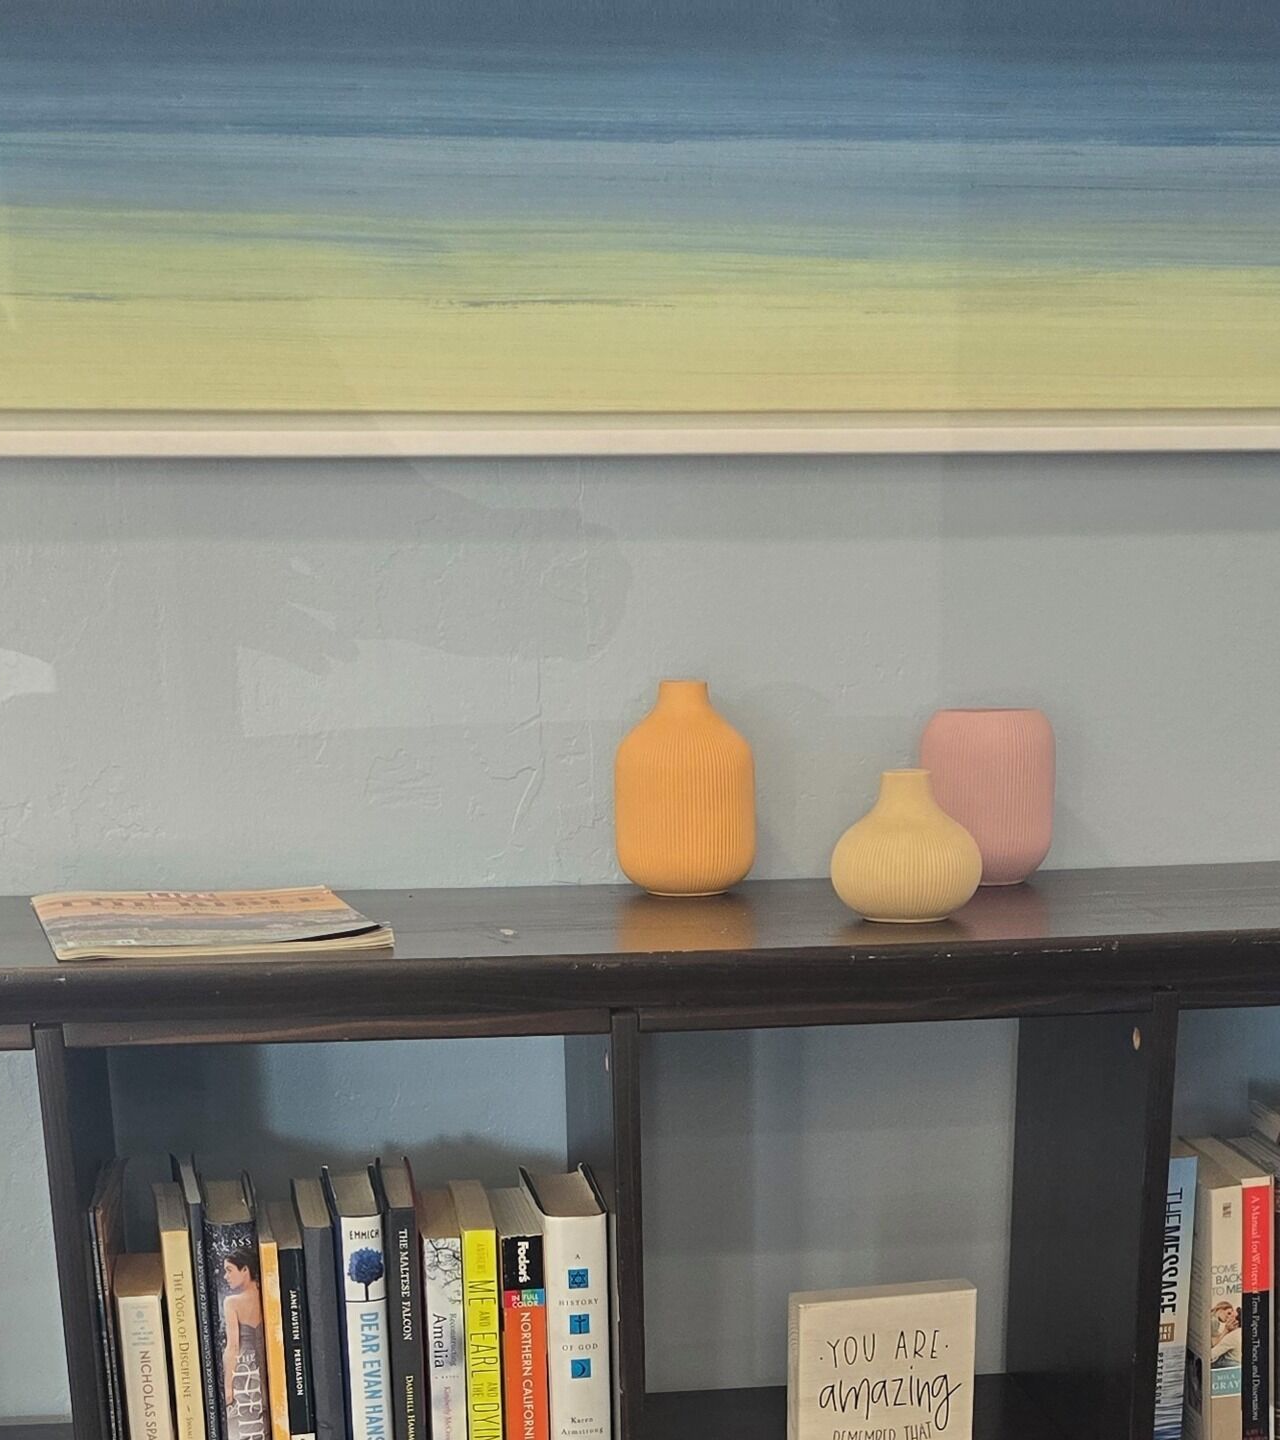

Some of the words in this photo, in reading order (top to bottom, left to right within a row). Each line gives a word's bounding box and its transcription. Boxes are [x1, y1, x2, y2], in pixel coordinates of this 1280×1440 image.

[349, 1229, 380, 1240] EMMICH
[398, 1228, 408, 1249] THE
[399, 1250, 411, 1298] MALTESE
[1211, 1263, 1238, 1275] COME
[289, 1290, 298, 1310] JANE
[558, 1298, 599, 1307] HISTORY
[291, 1311, 301, 1340] AUSTEN
[359, 1312, 380, 1354] DEAR
[401, 1301, 413, 1341] FALCON
[432, 1313, 449, 1369] Amelia
[520, 1312, 533, 1377] NORTHERN
[827, 1333, 875, 1368] YOU
[895, 1330, 940, 1359] ARE
[140, 1351, 156, 1422] NICHOLAS
[293, 1349, 304, 1396] PERSUASION
[362, 1363, 382, 1399] EVAN
[819, 1365, 963, 1431] amazing
